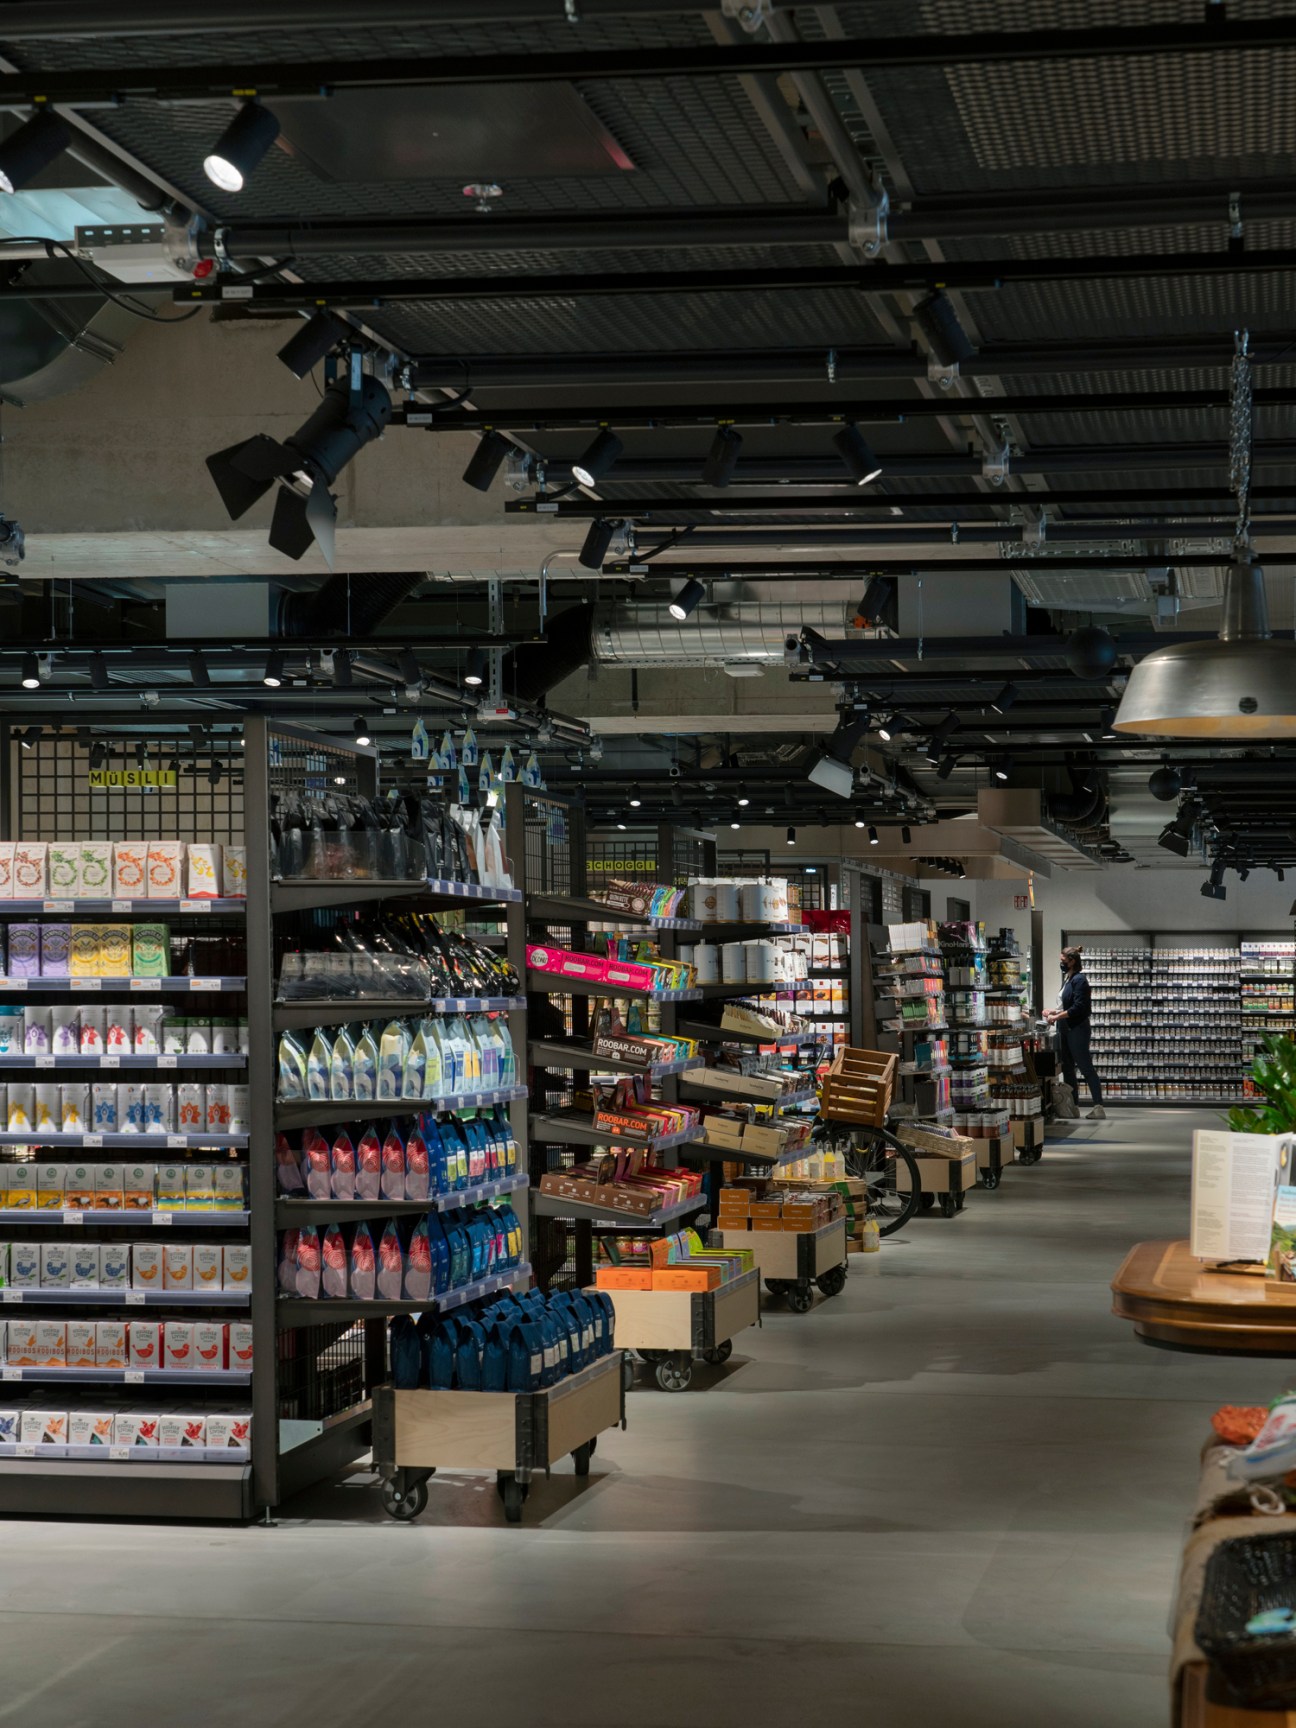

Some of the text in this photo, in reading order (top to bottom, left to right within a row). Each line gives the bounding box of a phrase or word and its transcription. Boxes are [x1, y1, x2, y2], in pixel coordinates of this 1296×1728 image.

[90, 772, 168, 785] MÜSLI
[586, 861, 652, 870] SCHOGGI
[597, 1038, 647, 1056] ROOBAR.COM
[597, 1113, 647, 1131] ROOBAR.COM
